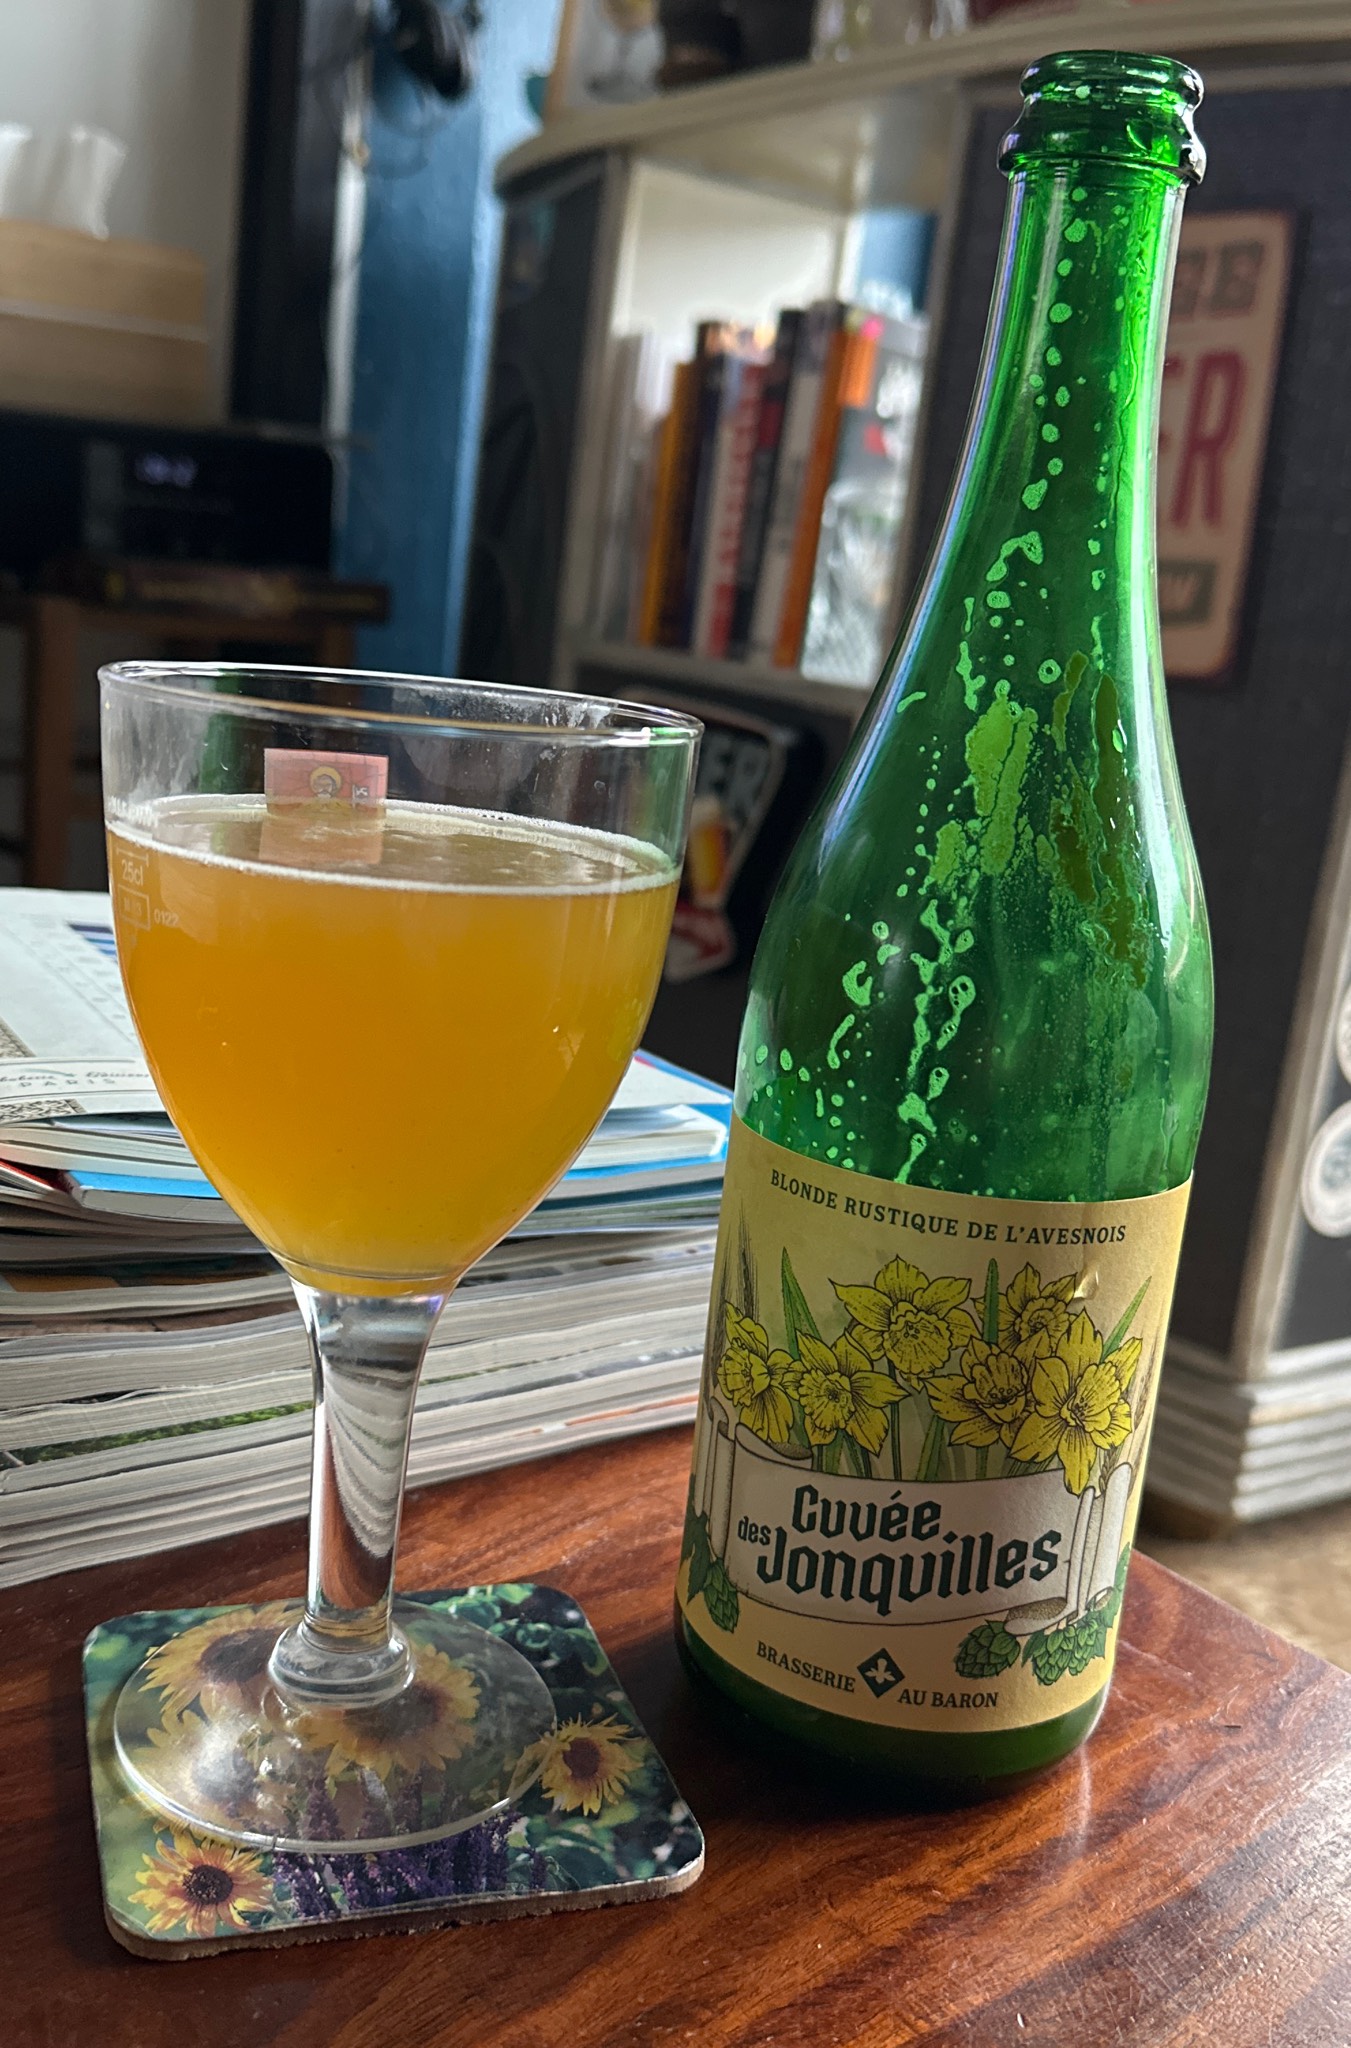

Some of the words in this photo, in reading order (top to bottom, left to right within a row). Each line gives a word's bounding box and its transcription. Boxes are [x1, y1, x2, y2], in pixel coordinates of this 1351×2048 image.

[122, 859, 144, 886] 25cl
[770, 1168, 838, 1210] BLONDE
[844, 1196, 959, 1236] RUSTIQUE
[966, 1221, 998, 1241] DE
[1005, 1225, 1126, 1245] L'AVESNOIS
[791, 1484, 942, 1542] Cuvée
[738, 1516, 771, 1546] des
[756, 1526, 1062, 1617] Jonquilles
[757, 1640, 856, 1693] BRASSERIE
[897, 1688, 927, 1706] AU
[931, 1691, 999, 1708] BARON
